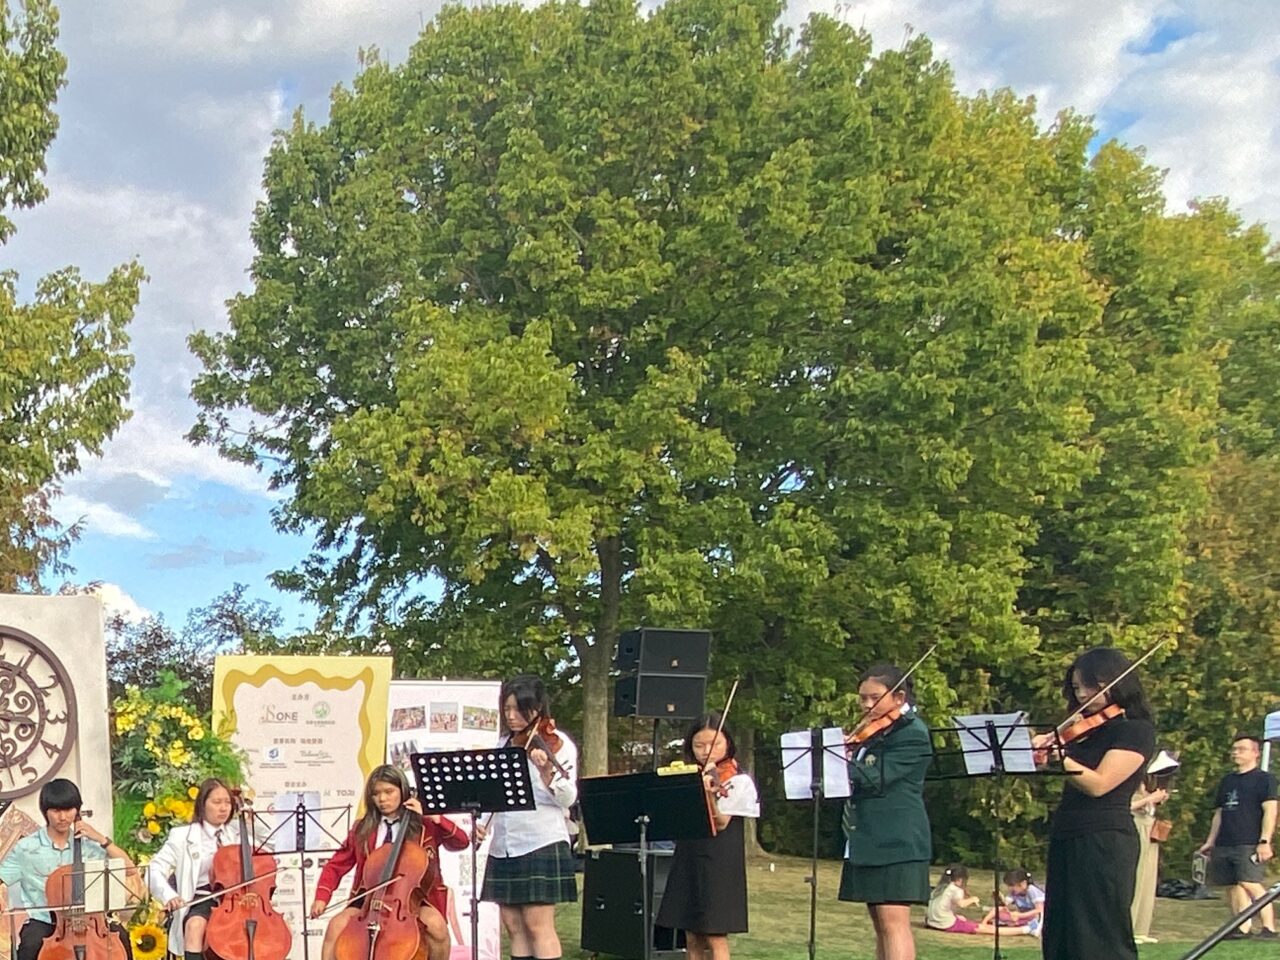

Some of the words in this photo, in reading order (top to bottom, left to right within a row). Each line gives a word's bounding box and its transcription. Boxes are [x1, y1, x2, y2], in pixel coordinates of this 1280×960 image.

[39, 675, 60, 698] 2
[45, 709, 68, 725] 3
[40, 739, 62, 759] 4
[19, 759, 38, 784] 5
